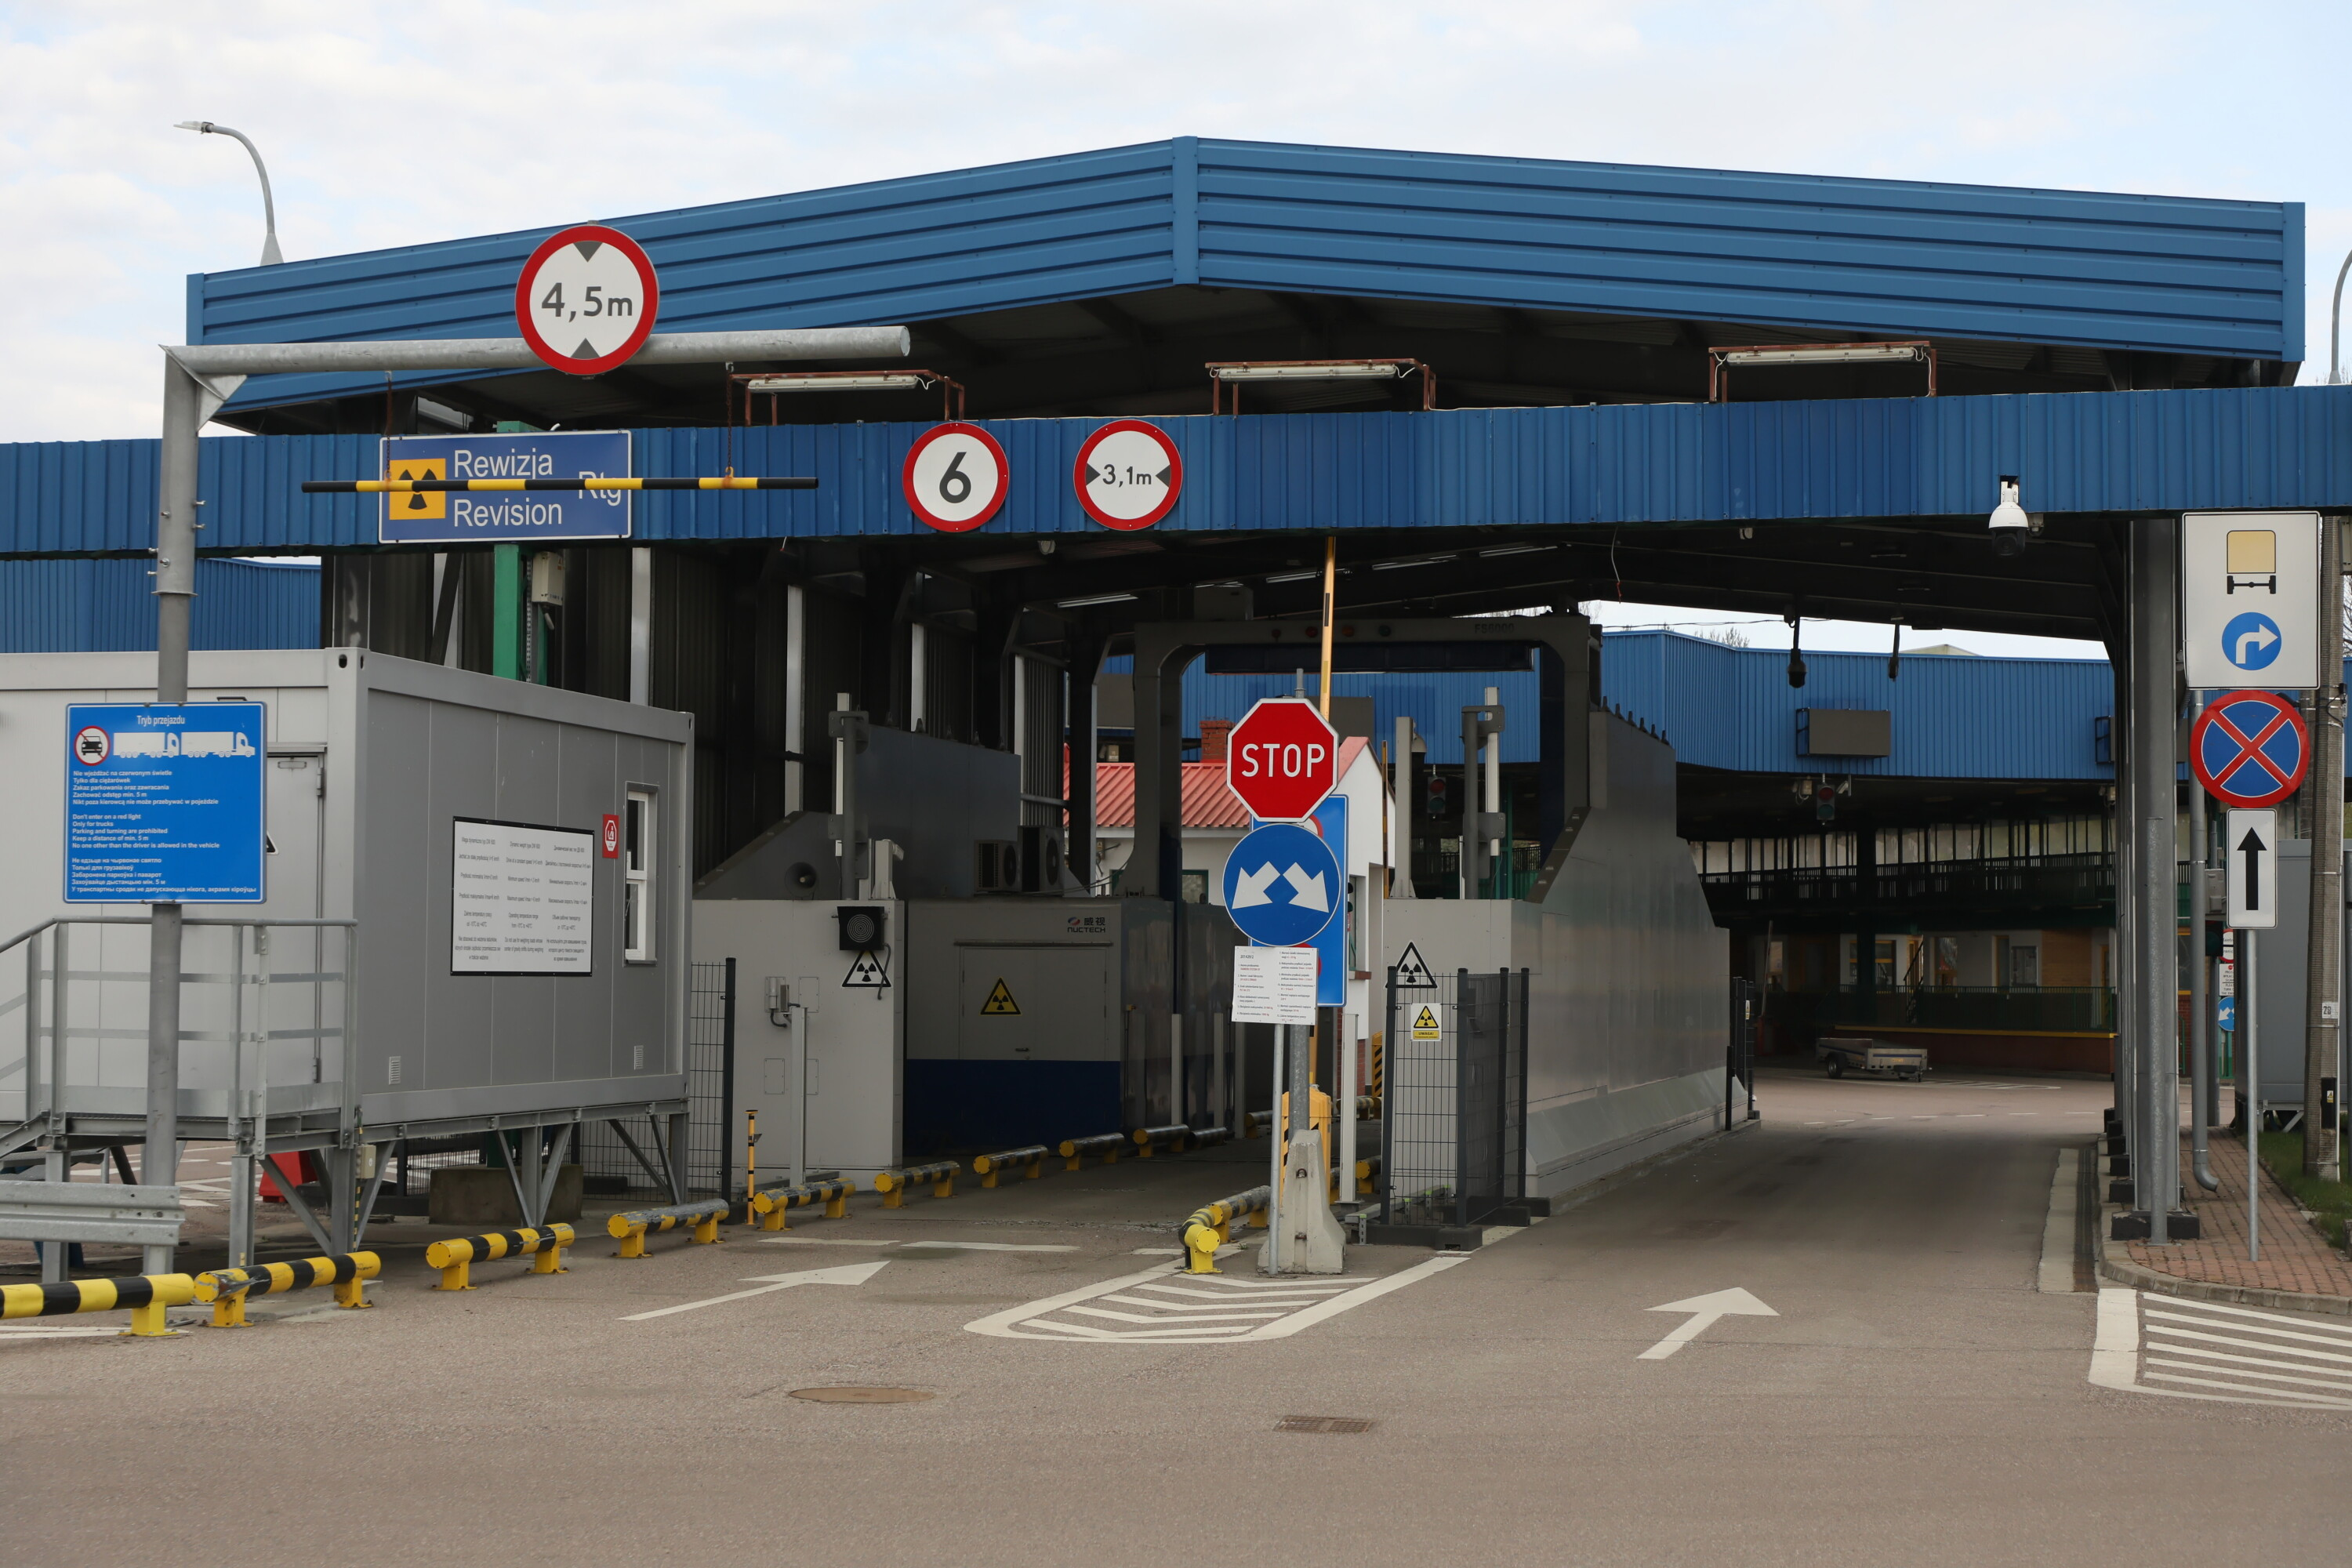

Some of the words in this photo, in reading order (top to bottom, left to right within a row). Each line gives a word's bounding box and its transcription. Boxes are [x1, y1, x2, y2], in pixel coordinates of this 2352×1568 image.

[541, 282, 633, 323] 4,5m
[454, 448, 554, 481] Rewizja
[939, 452, 971, 503] 6
[1102, 463, 1152, 488] 3,1m
[454, 497, 562, 527] Revision
[136, 715, 152, 727] Tryb
[153, 715, 185, 727] przejazdu
[1242, 743, 1325, 778] STOP
